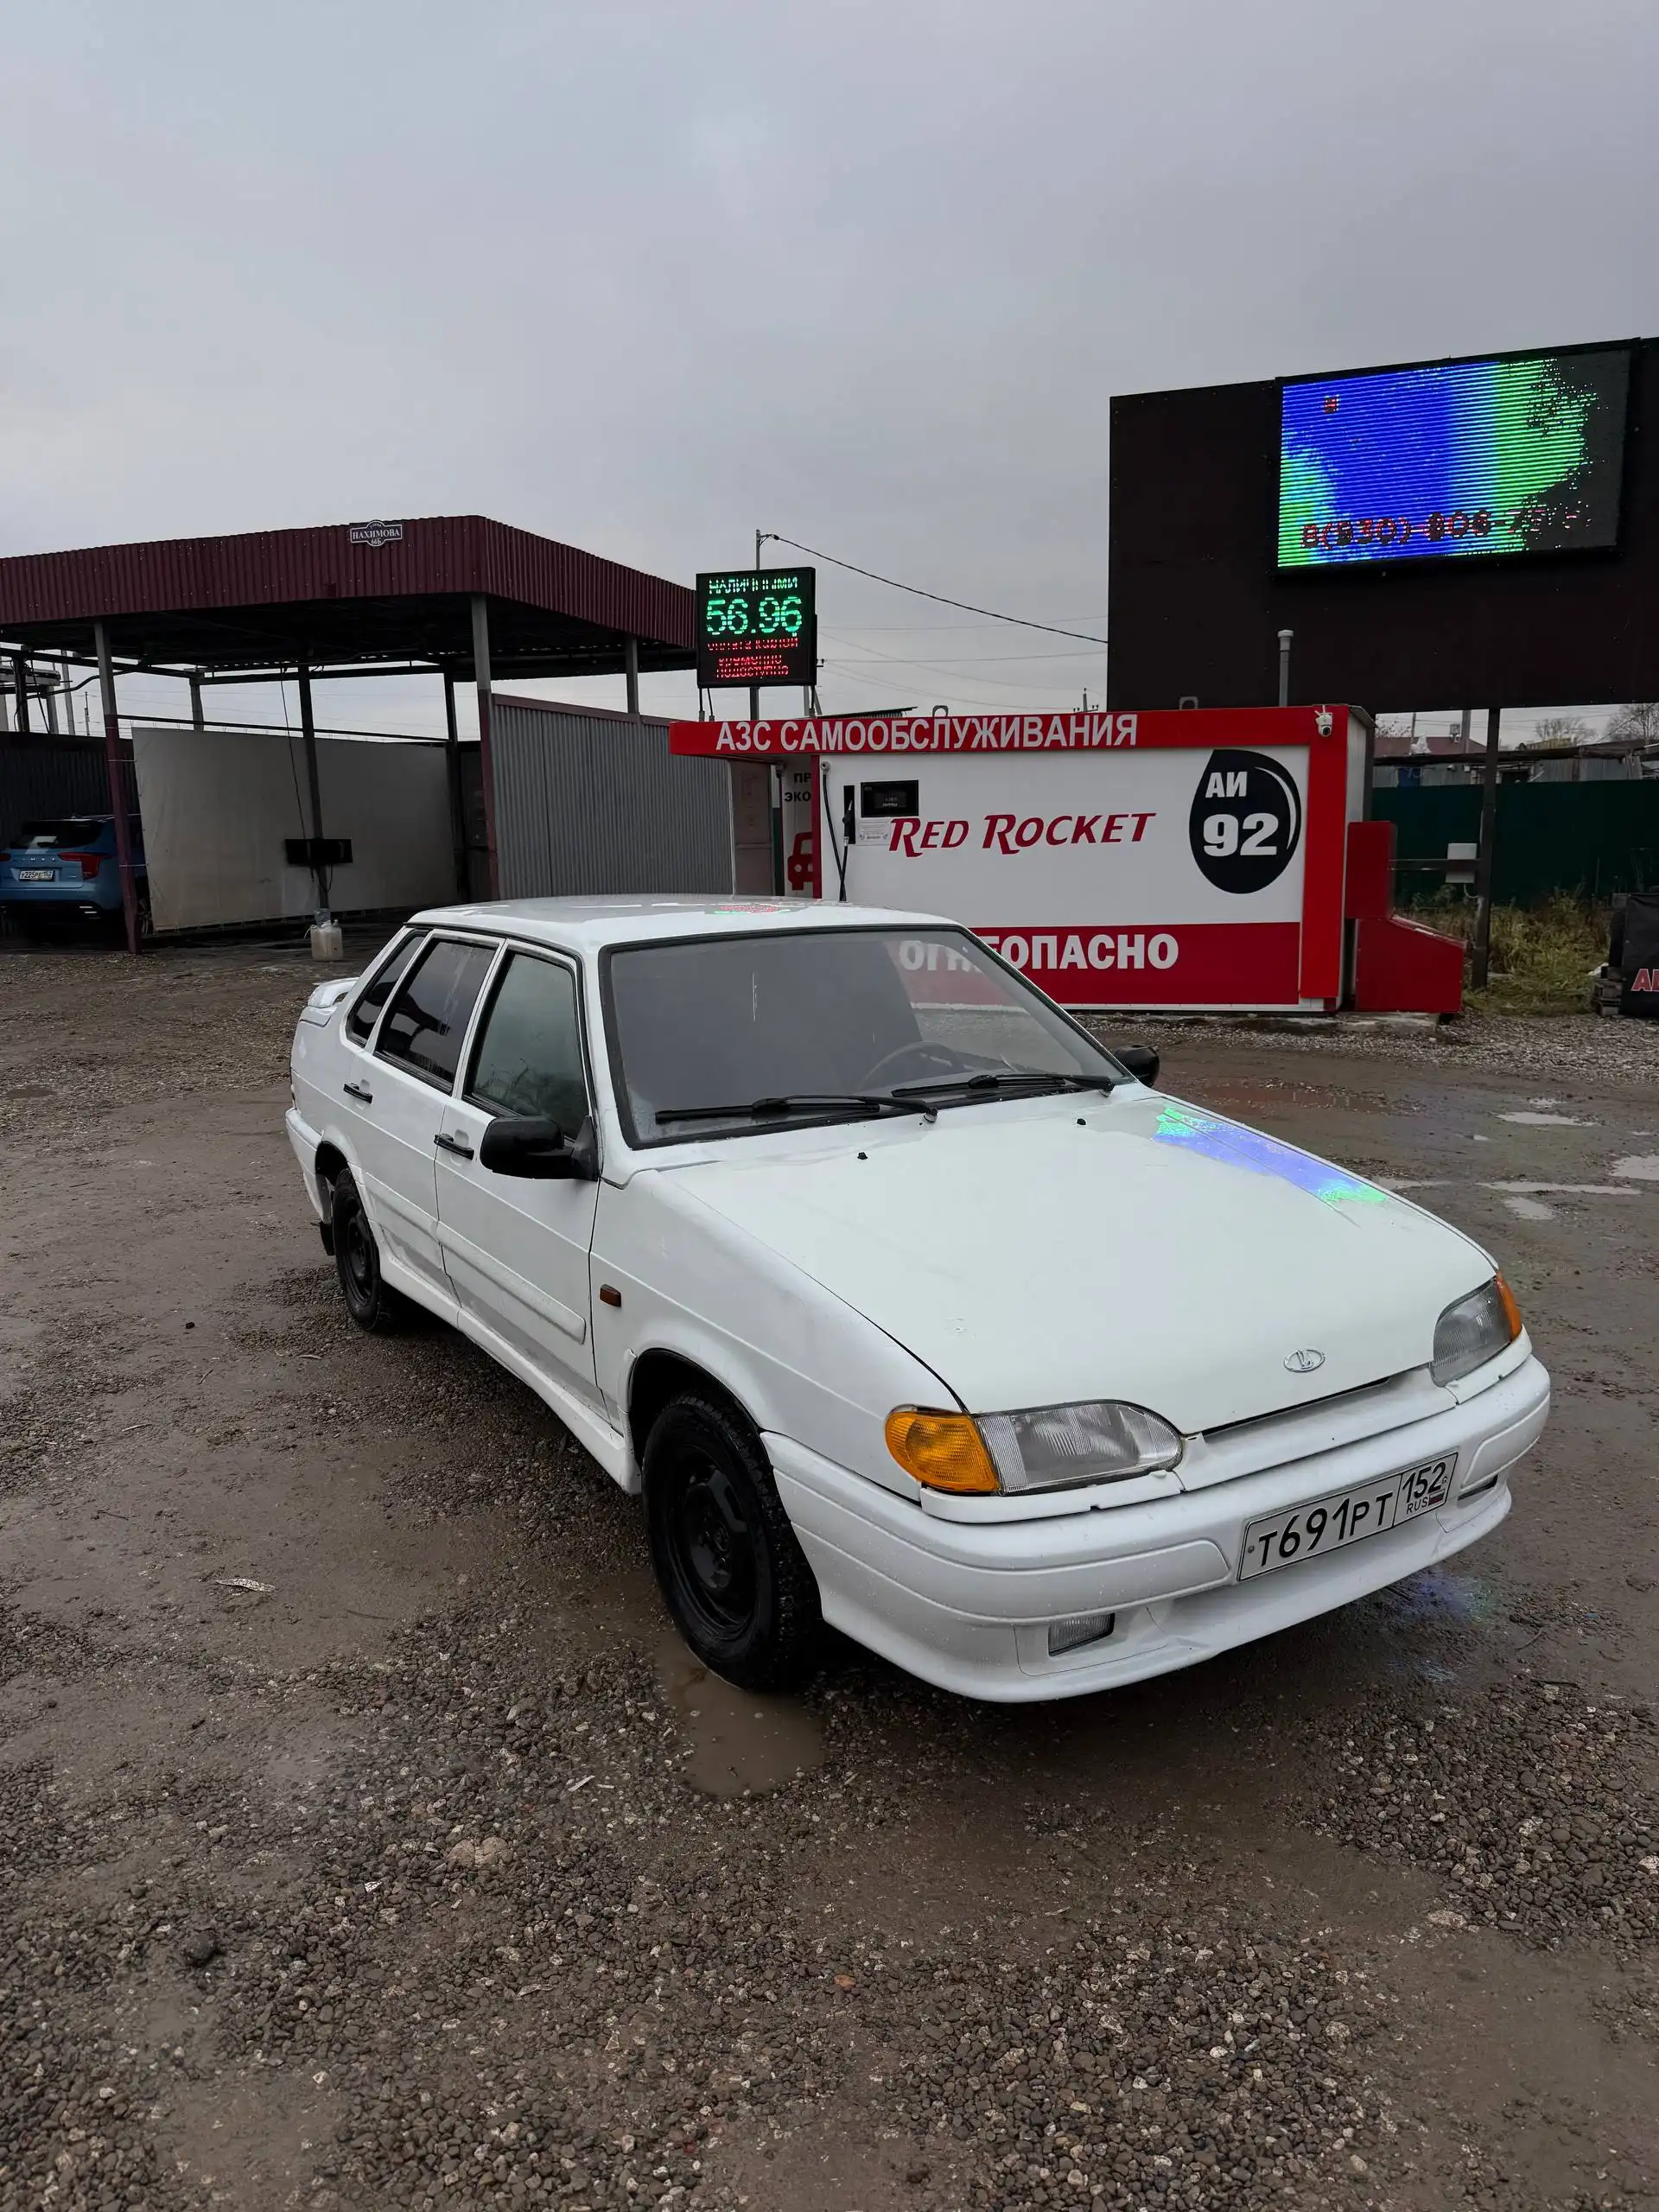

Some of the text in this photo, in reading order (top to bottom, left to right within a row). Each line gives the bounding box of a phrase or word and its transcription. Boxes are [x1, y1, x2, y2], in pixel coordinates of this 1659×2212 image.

[353, 529, 400, 540] НАХИМОВА
[707, 596, 802, 636] 56.96
[715, 714, 1138, 751] АЗС САМООБСЛУЖИВАНИЯ
[1205, 771, 1248, 798] АИ
[1204, 812, 1279, 857] 92
[1402, 1461, 1446, 1503] 152
[1407, 1497, 1427, 1515] RUS
